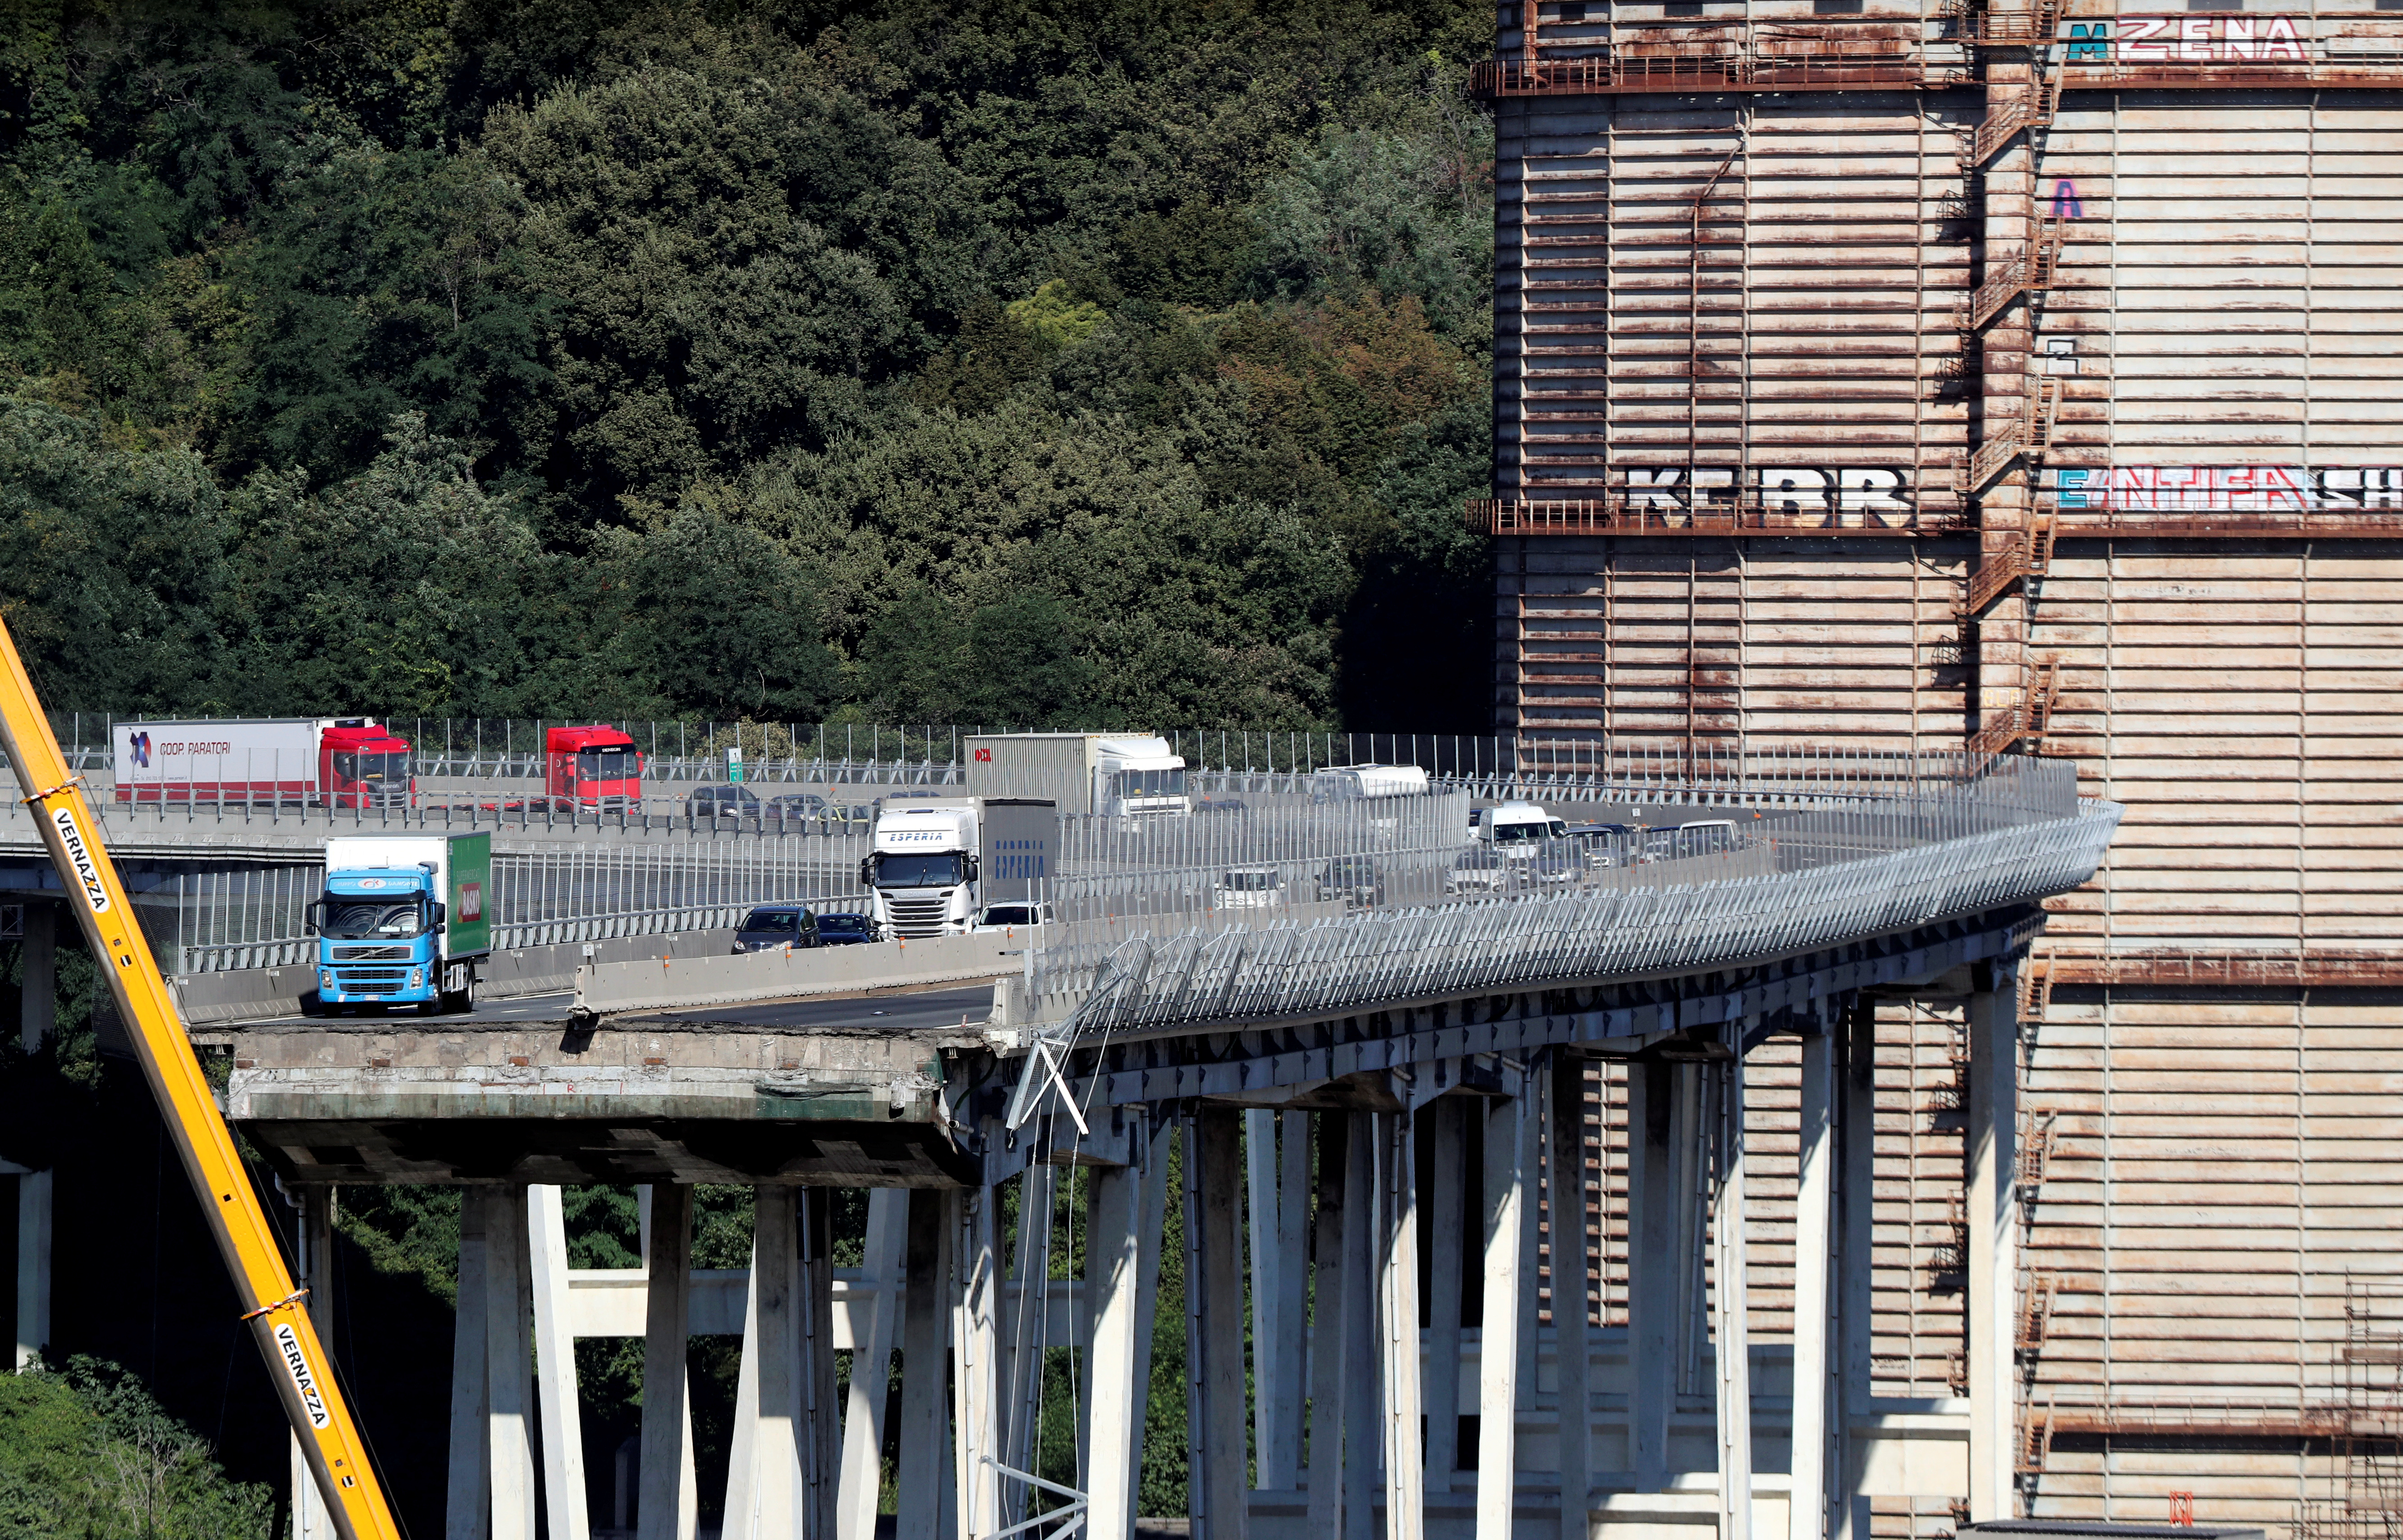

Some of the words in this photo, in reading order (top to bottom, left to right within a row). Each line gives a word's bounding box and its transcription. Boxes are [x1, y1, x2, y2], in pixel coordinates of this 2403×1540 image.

[2117, 14, 2305, 60] ZENA
[160, 742, 184, 755] COOP.
[188, 741, 231, 755] PARATORI
[890, 832, 943, 841] ESPERIA
[57, 812, 105, 909] VERNAZZA
[995, 840, 1044, 879] ESPERIA
[462, 889, 480, 916] BASKO
[279, 1327, 325, 1425] VERNAZZA
